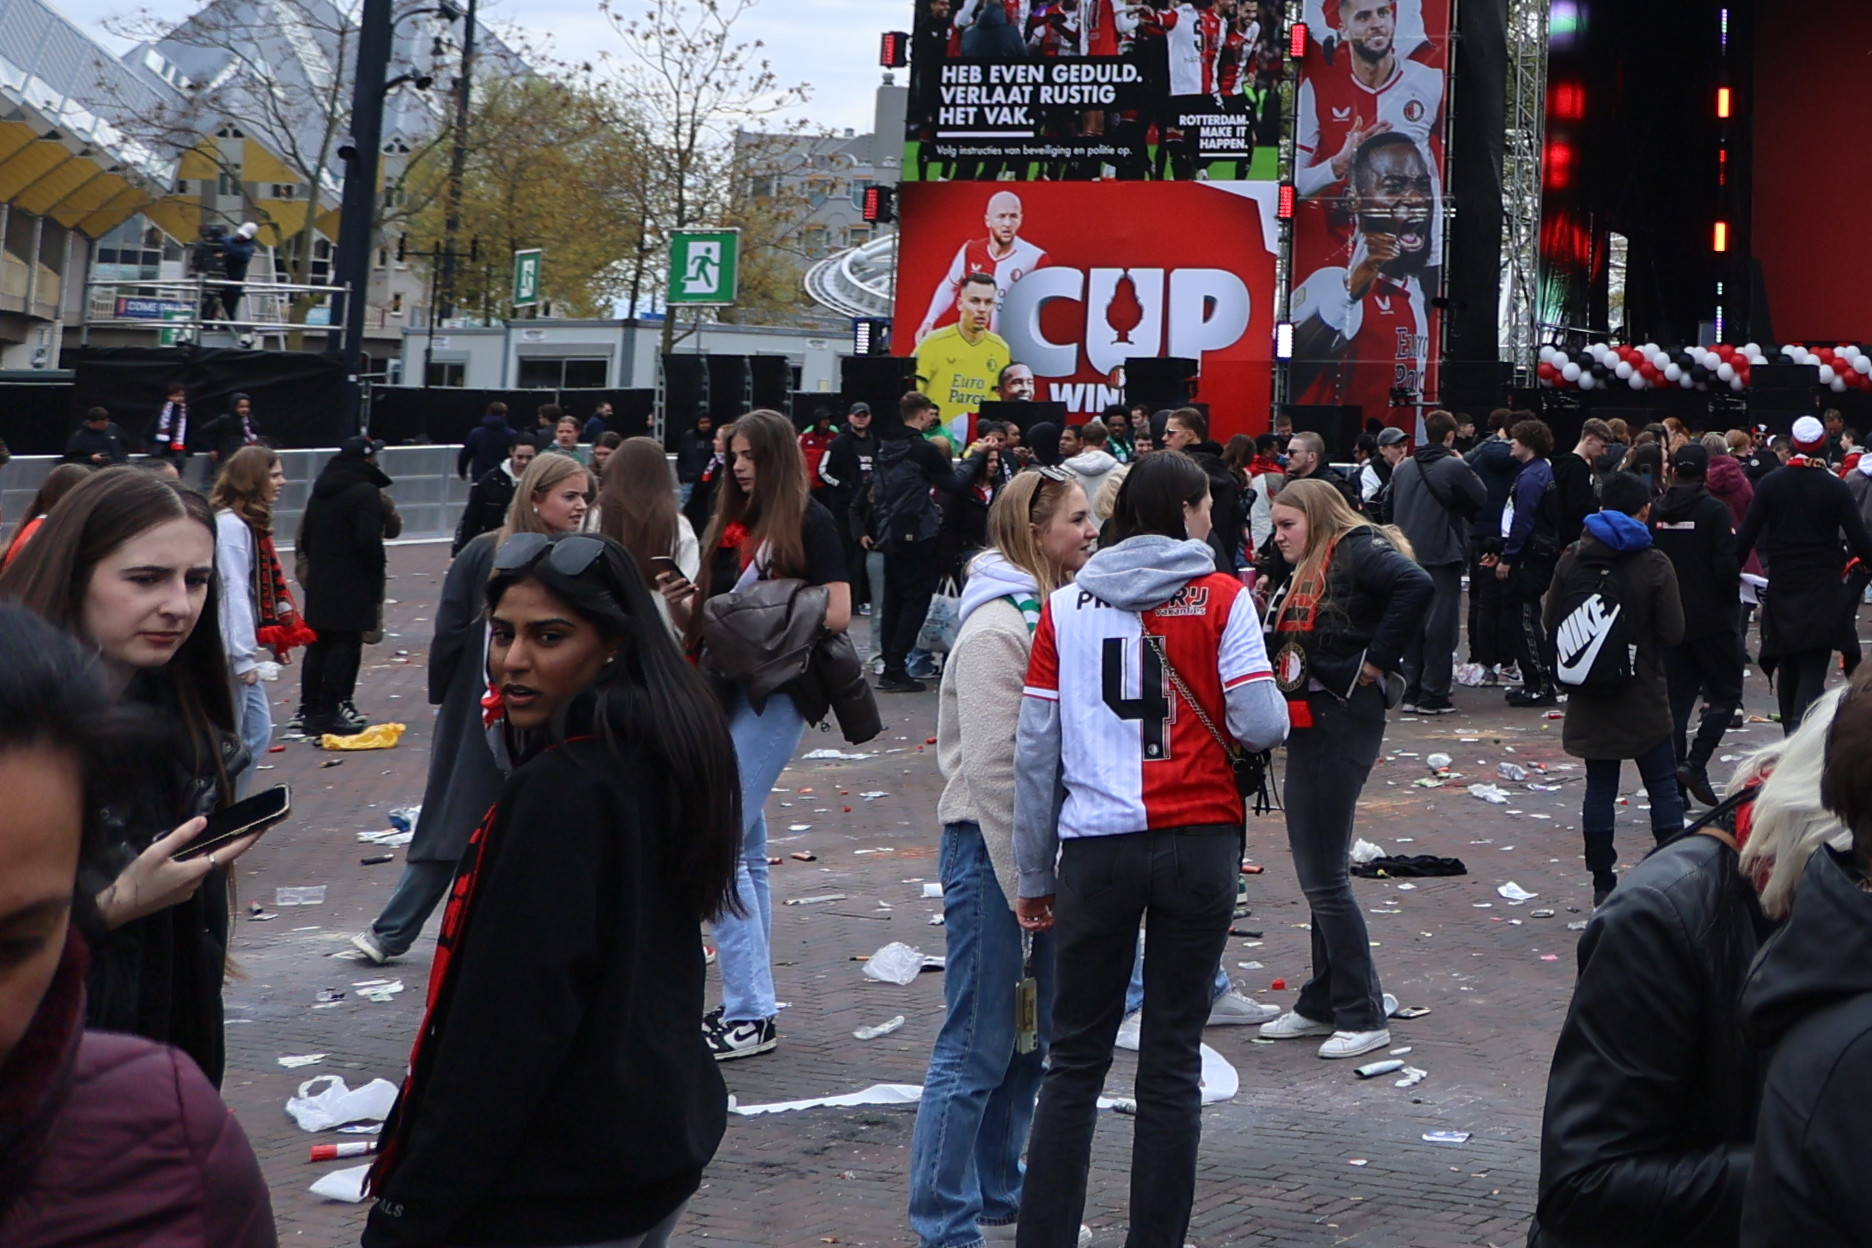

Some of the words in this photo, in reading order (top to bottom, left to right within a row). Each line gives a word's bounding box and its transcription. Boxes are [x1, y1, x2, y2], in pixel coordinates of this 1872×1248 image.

[941, 65, 983, 84] HEB
[990, 64, 1045, 83] EVEN
[1052, 64, 1143, 83] GEDULD.
[940, 86, 1033, 104] VERLAAT
[1040, 85, 1117, 104] RUSTIG
[938, 107, 978, 125] HET
[984, 106, 1035, 125] VAK.
[1179, 114, 1249, 126] ROTTERDAM.
[1200, 126, 1232, 138] MAKE
[1236, 126, 1247, 138] IT
[936, 145, 957, 158] Volg
[959, 145, 1002, 155] instructies
[1004, 147, 1021, 155] van
[1073, 146, 1085, 155] en
[1087, 144, 1115, 158] politie
[1199, 138, 1248, 150] HAPPEN.
[1000, 266, 1251, 378] CUP
[952, 373, 985, 390] Euro
[1049, 383, 1126, 413] WIN
[1556, 593, 1610, 665] NIKE
[1101, 635, 1177, 762] 4
